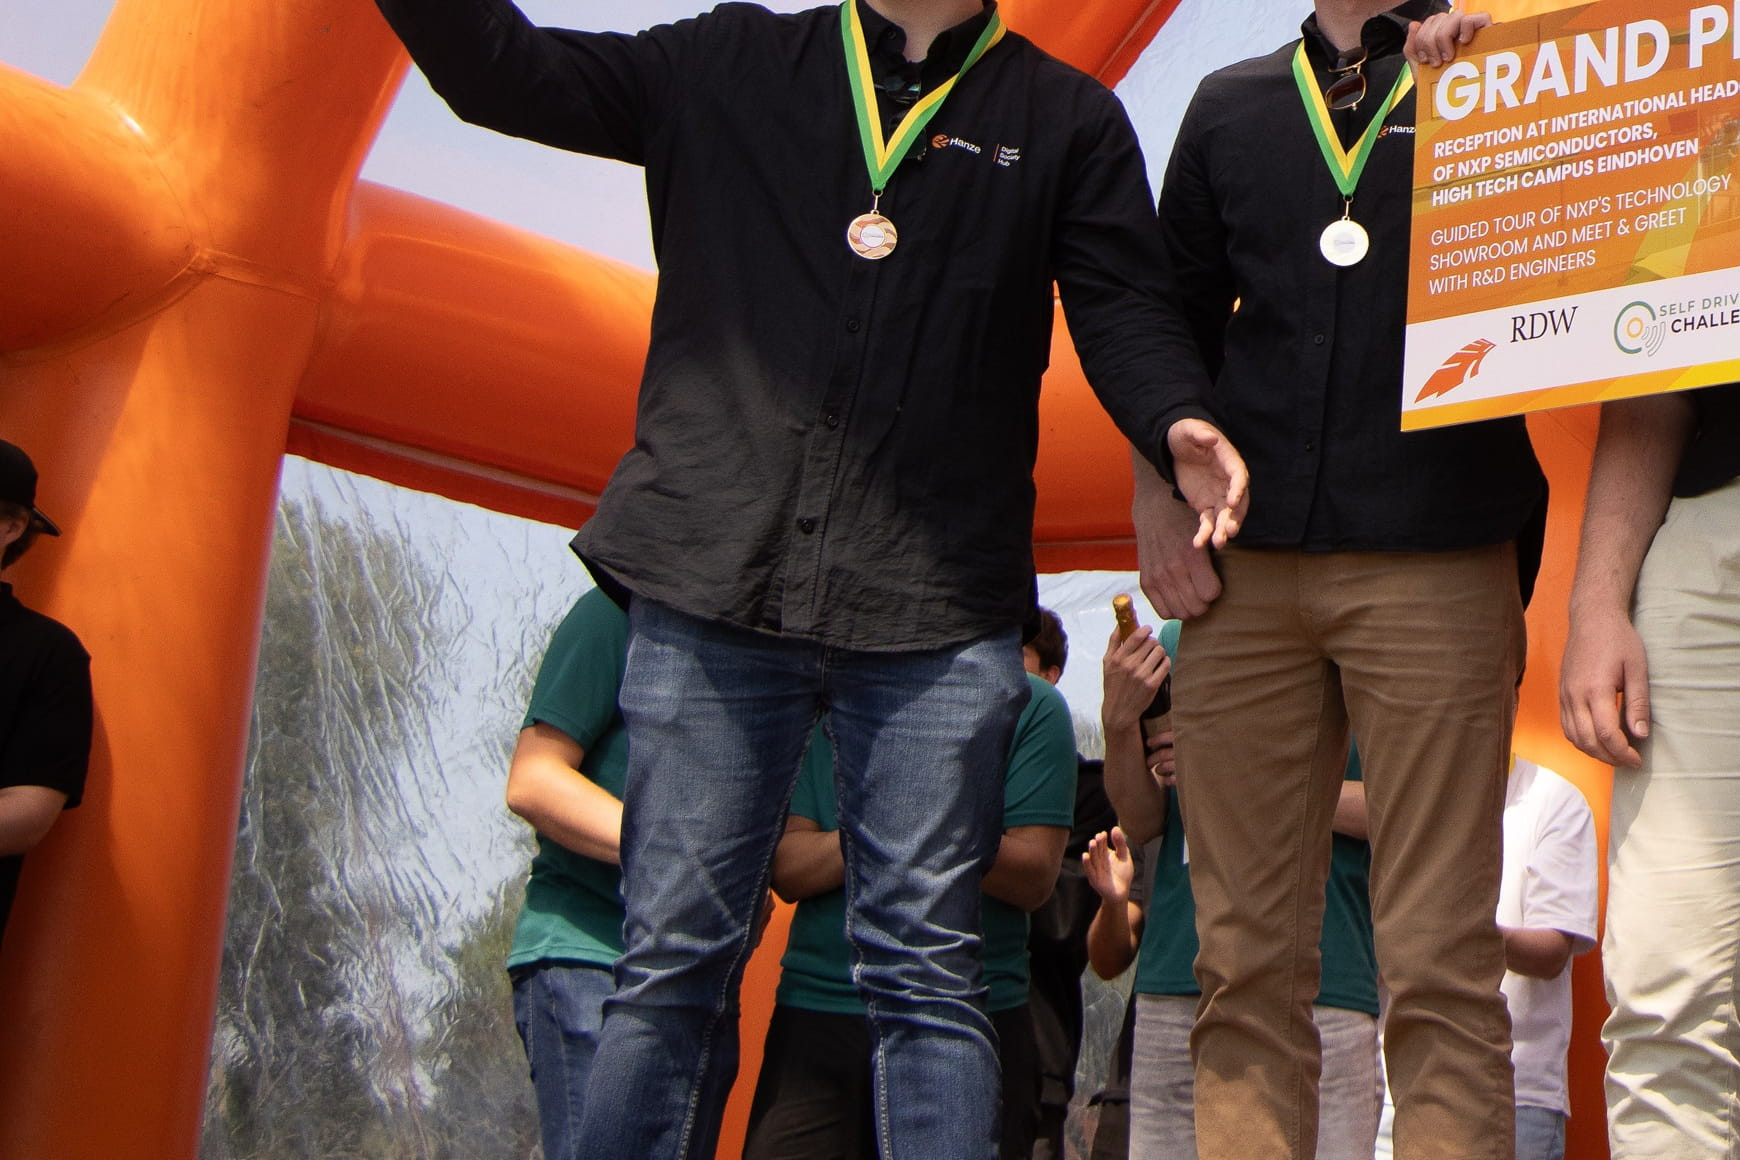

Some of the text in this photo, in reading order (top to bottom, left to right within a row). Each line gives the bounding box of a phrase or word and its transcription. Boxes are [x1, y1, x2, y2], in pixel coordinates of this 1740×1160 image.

[1435, 19, 1671, 121] GRAND
[950, 138, 981, 154] Hanze
[1389, 125, 1416, 134] Hanz
[1433, 123, 1659, 183] OF NXP SEMICONDUCTORS,
[1434, 124, 1523, 158] RECEPTION
[1526, 118, 1548, 138] AT
[1551, 89, 1688, 133] INTERNATIONAL
[1432, 139, 1699, 207] HIGH TECH CAMPUS EINDHOVEN
[1430, 206, 1687, 272] SHOWROOM AND MEET & GREET
[1431, 173, 1733, 246] GUIDED TOUR OF NXP'S TECHNOLOGY
[1428, 249, 1597, 296] WITH R&D ENGINEERS
[1510, 305, 1580, 343] RDW
[1659, 299, 1697, 318] SELF
